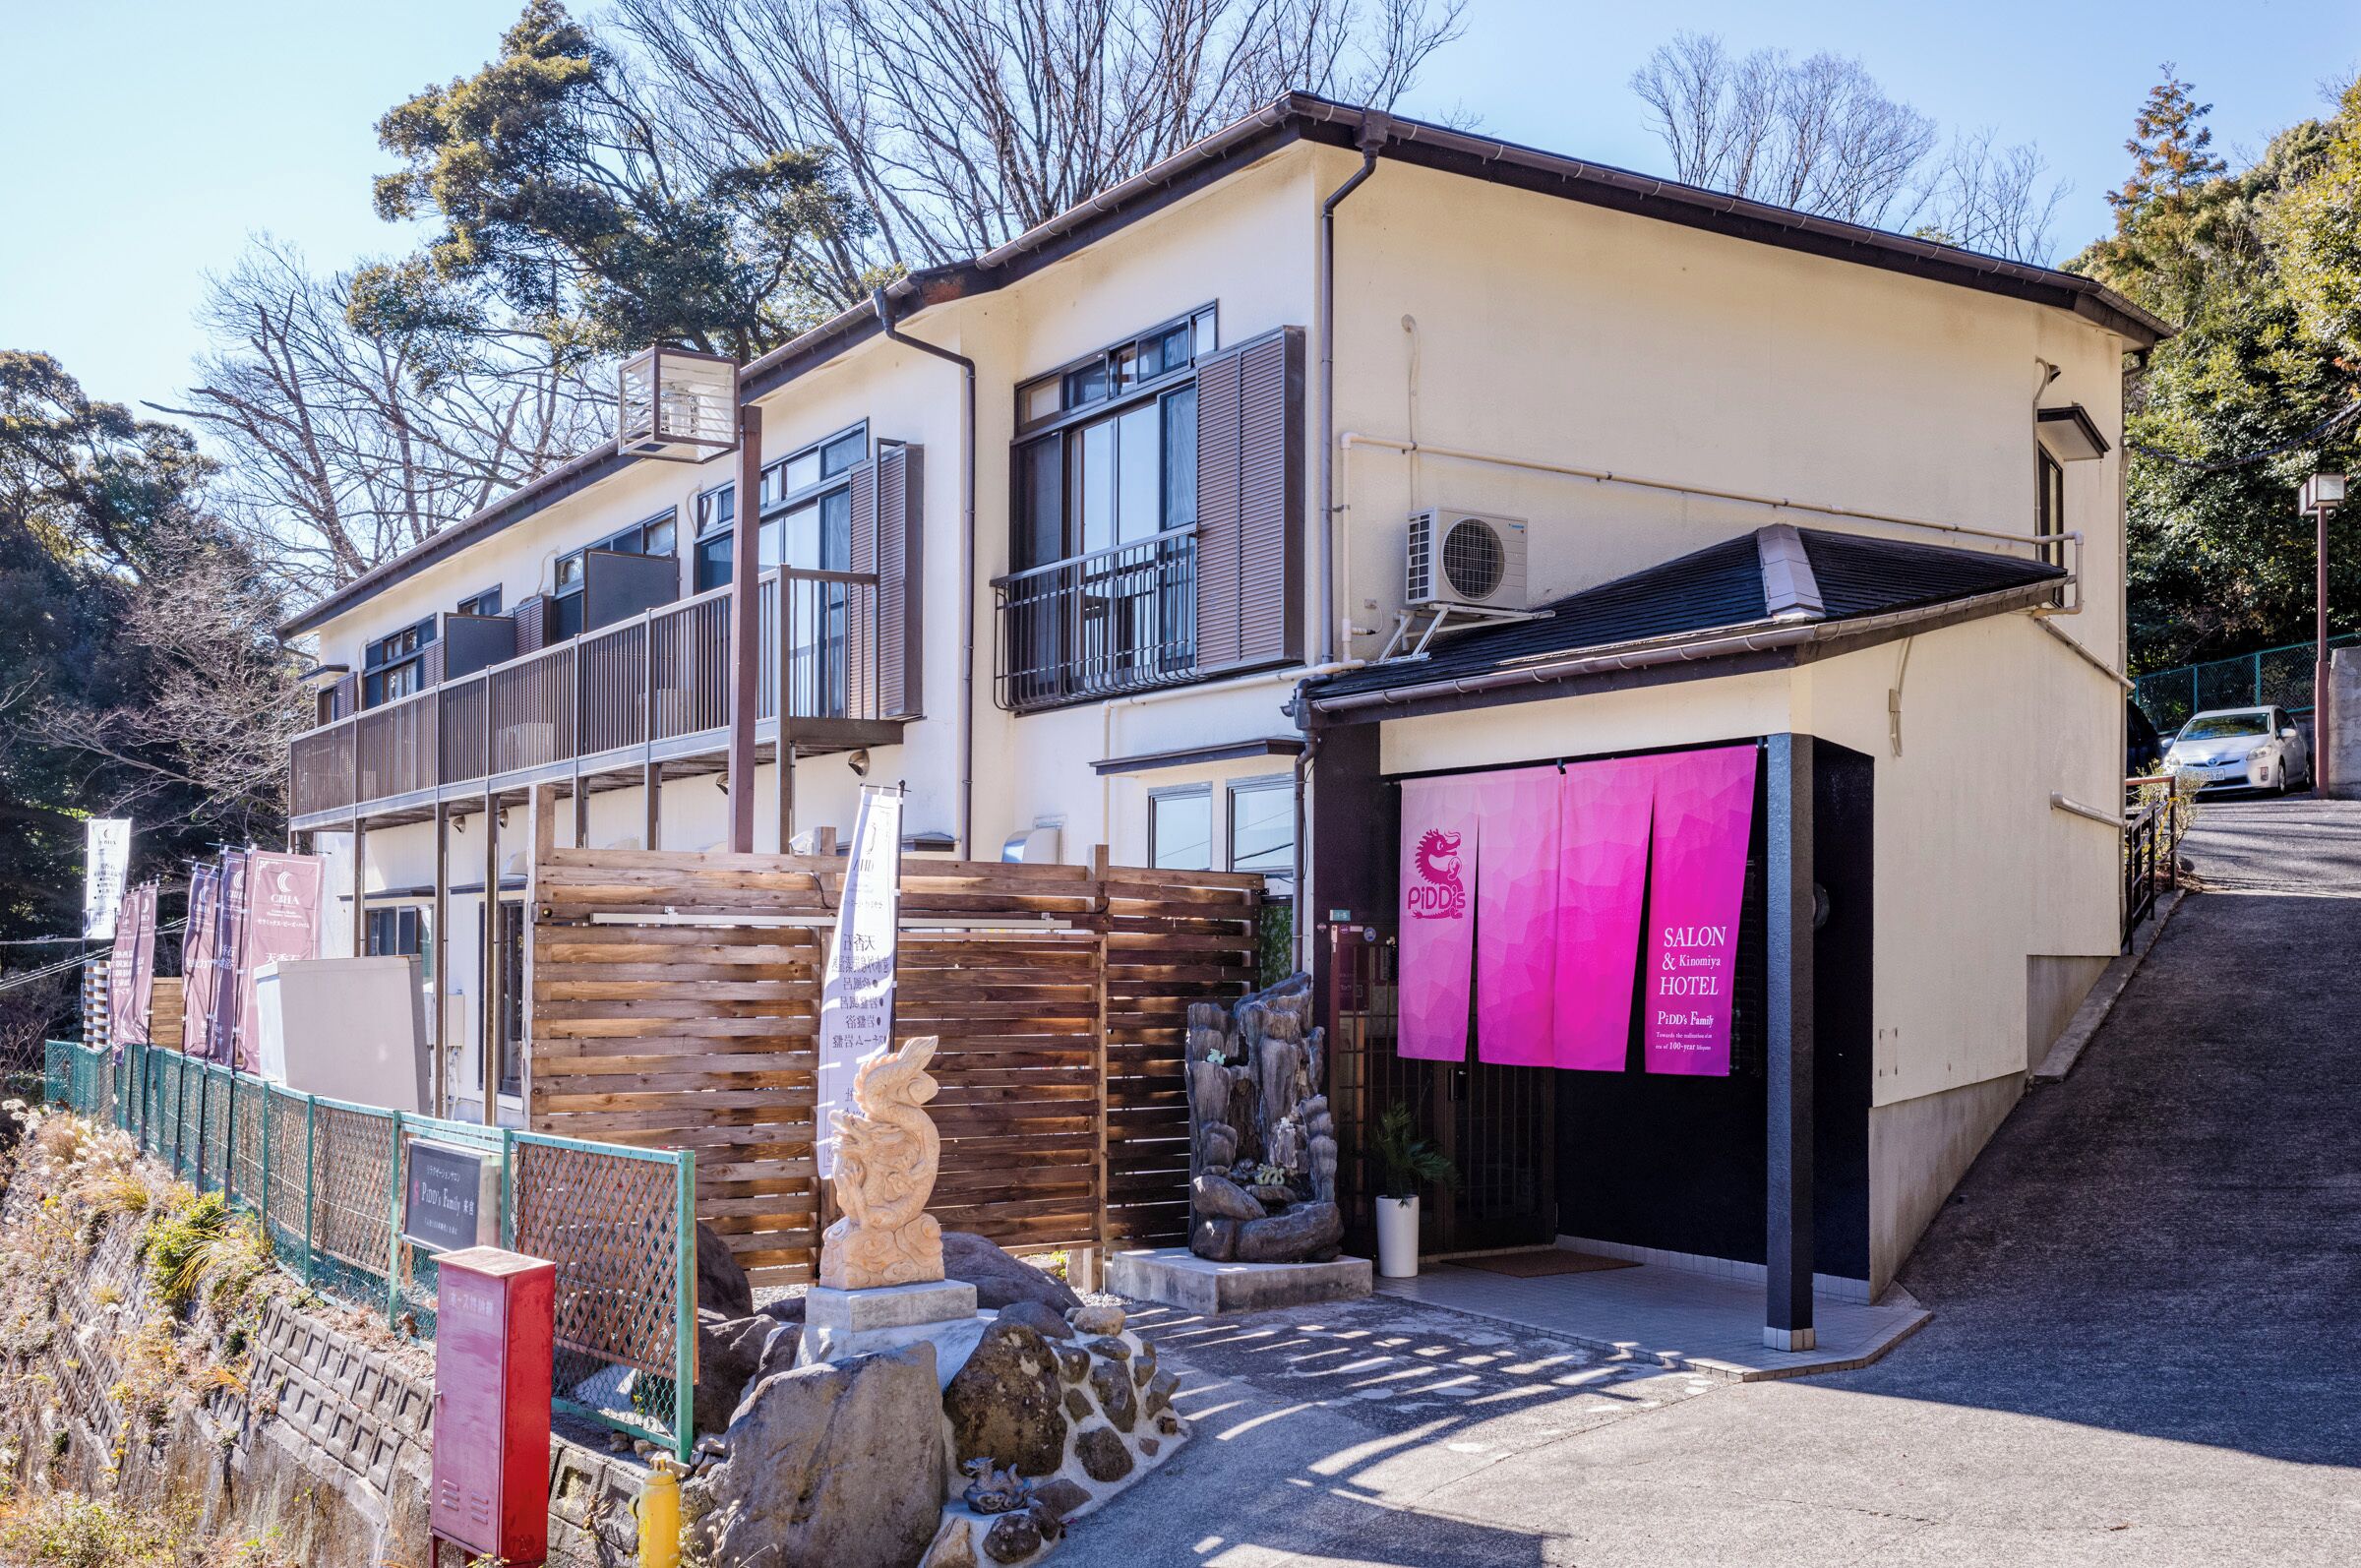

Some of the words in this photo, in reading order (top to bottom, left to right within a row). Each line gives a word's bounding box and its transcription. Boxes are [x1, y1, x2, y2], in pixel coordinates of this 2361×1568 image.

[271, 893, 299, 905] CBHA
[1408, 885, 1466, 910] PiDD's
[1664, 926, 1726, 947] SALON
[1662, 952, 1676, 971] &
[1679, 954, 1721, 969] Kinomiya
[1660, 976, 1720, 995] HOTEL
[1657, 1010, 1688, 1025] PiDD's
[1690, 1010, 1714, 1029] Family
[1669, 1042, 1695, 1052] 100-year
[421, 1181, 441, 1206] PiDD's
[443, 1187, 460, 1217] Family
